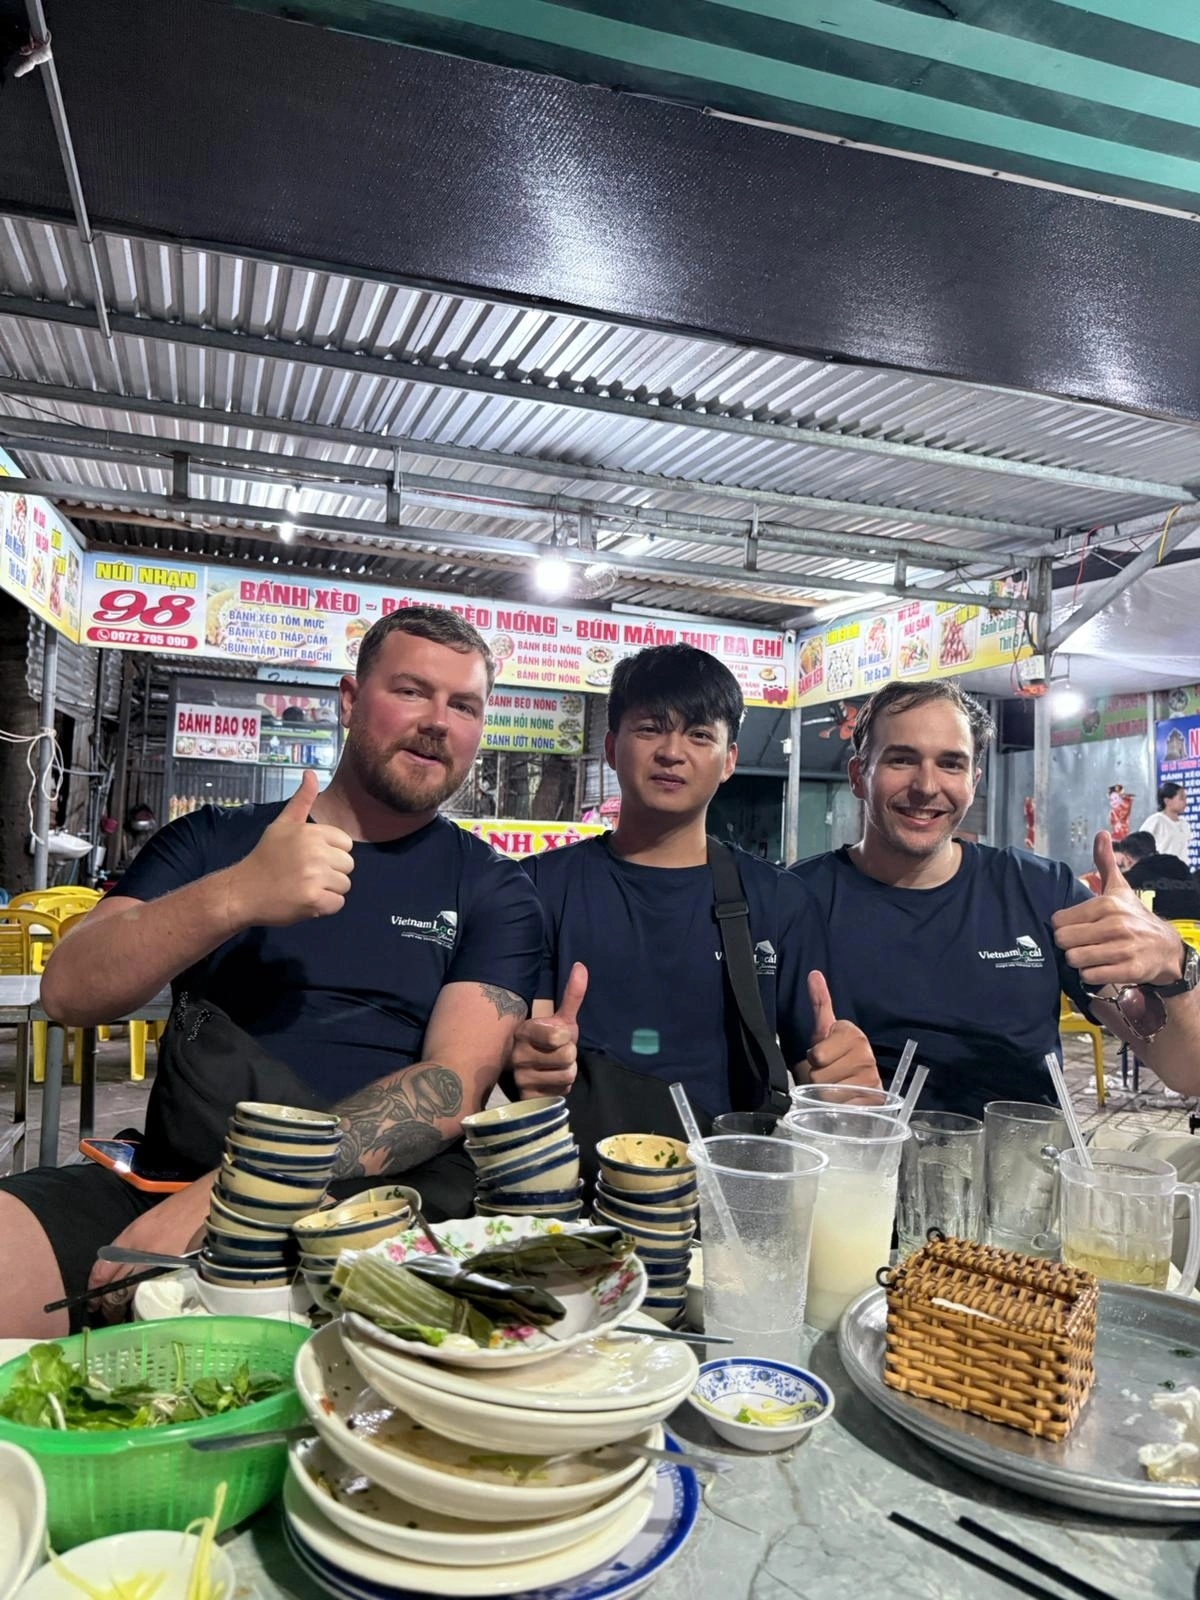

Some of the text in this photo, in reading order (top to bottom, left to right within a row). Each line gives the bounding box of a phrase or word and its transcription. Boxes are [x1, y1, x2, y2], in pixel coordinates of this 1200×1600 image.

[95, 561, 197, 591] NÚI NHẠN
[93, 589, 196, 628] 98
[229, 608, 256, 621] BÁNH
[281, 614, 300, 626] TÔM
[240, 580, 308, 608] BÁNH
[315, 588, 358, 614] XÈO
[497, 610, 555, 635] NÓNG
[577, 619, 617, 642] BÚN
[624, 621, 676, 646] MẮM
[723, 635, 748, 656] BA
[752, 635, 783, 658] CHỈ
[111, 631, 189, 647] 0972 795 090
[518, 640, 540, 651] BÁNH
[517, 655, 539, 666] BÁNH
[517, 669, 539, 680] BÁNH
[489, 695, 512, 707] BÁNH
[533, 697, 557, 711] NÓNG
[178, 709, 257, 737] BÁNH BAO 98
[487, 713, 511, 727] BÁNH
[530, 716, 554, 730] NÓNG
[487, 733, 510, 747] BÁNH
[531, 736, 555, 750] NÓNG
